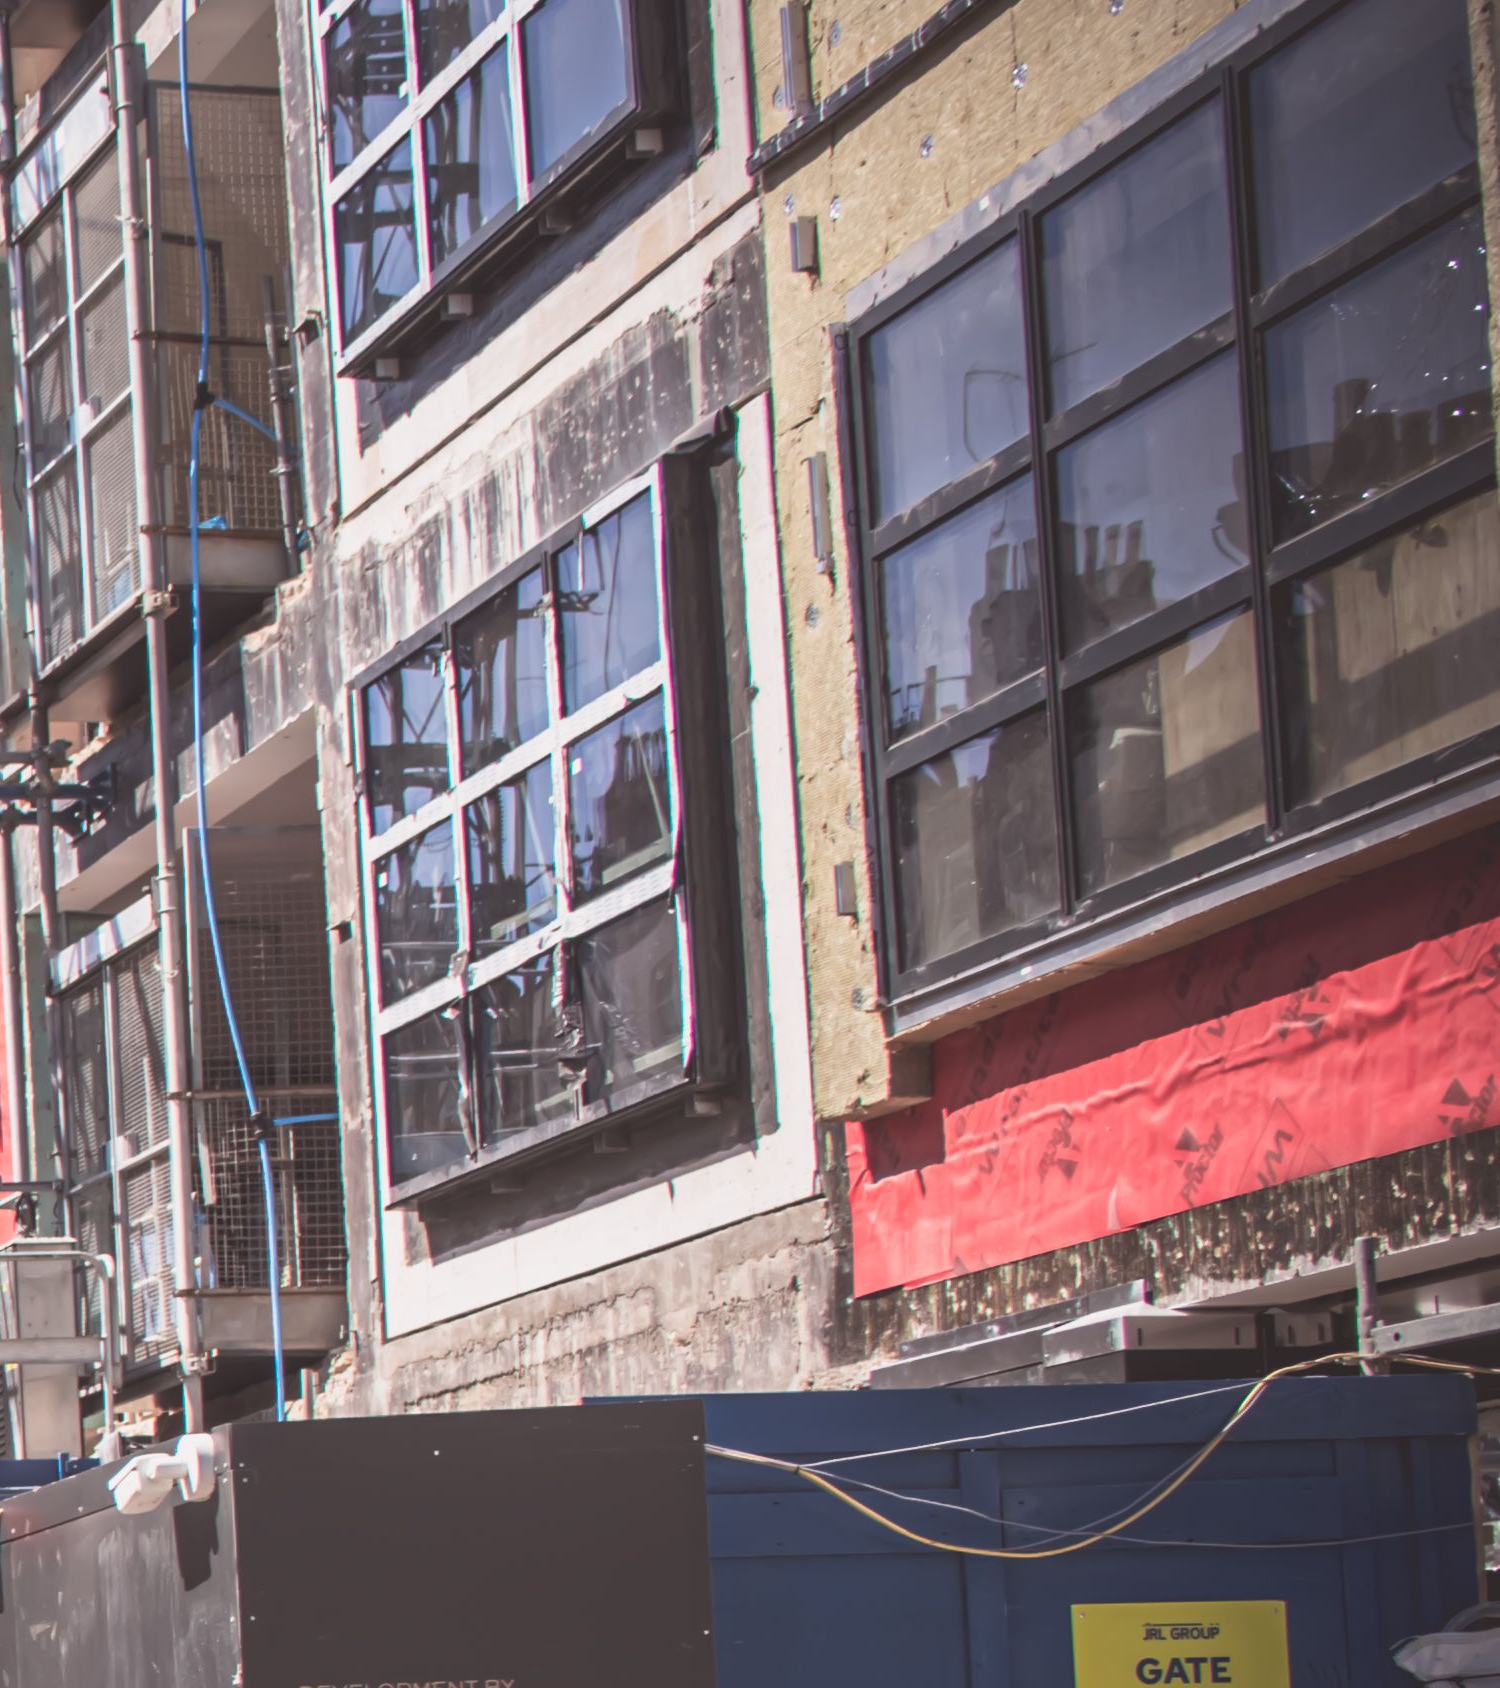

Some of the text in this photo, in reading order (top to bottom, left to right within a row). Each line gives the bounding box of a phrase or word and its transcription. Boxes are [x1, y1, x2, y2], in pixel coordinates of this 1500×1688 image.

[1143, 1626, 1220, 1640] JRL GROUP
[1136, 1657, 1232, 1685] GATE
